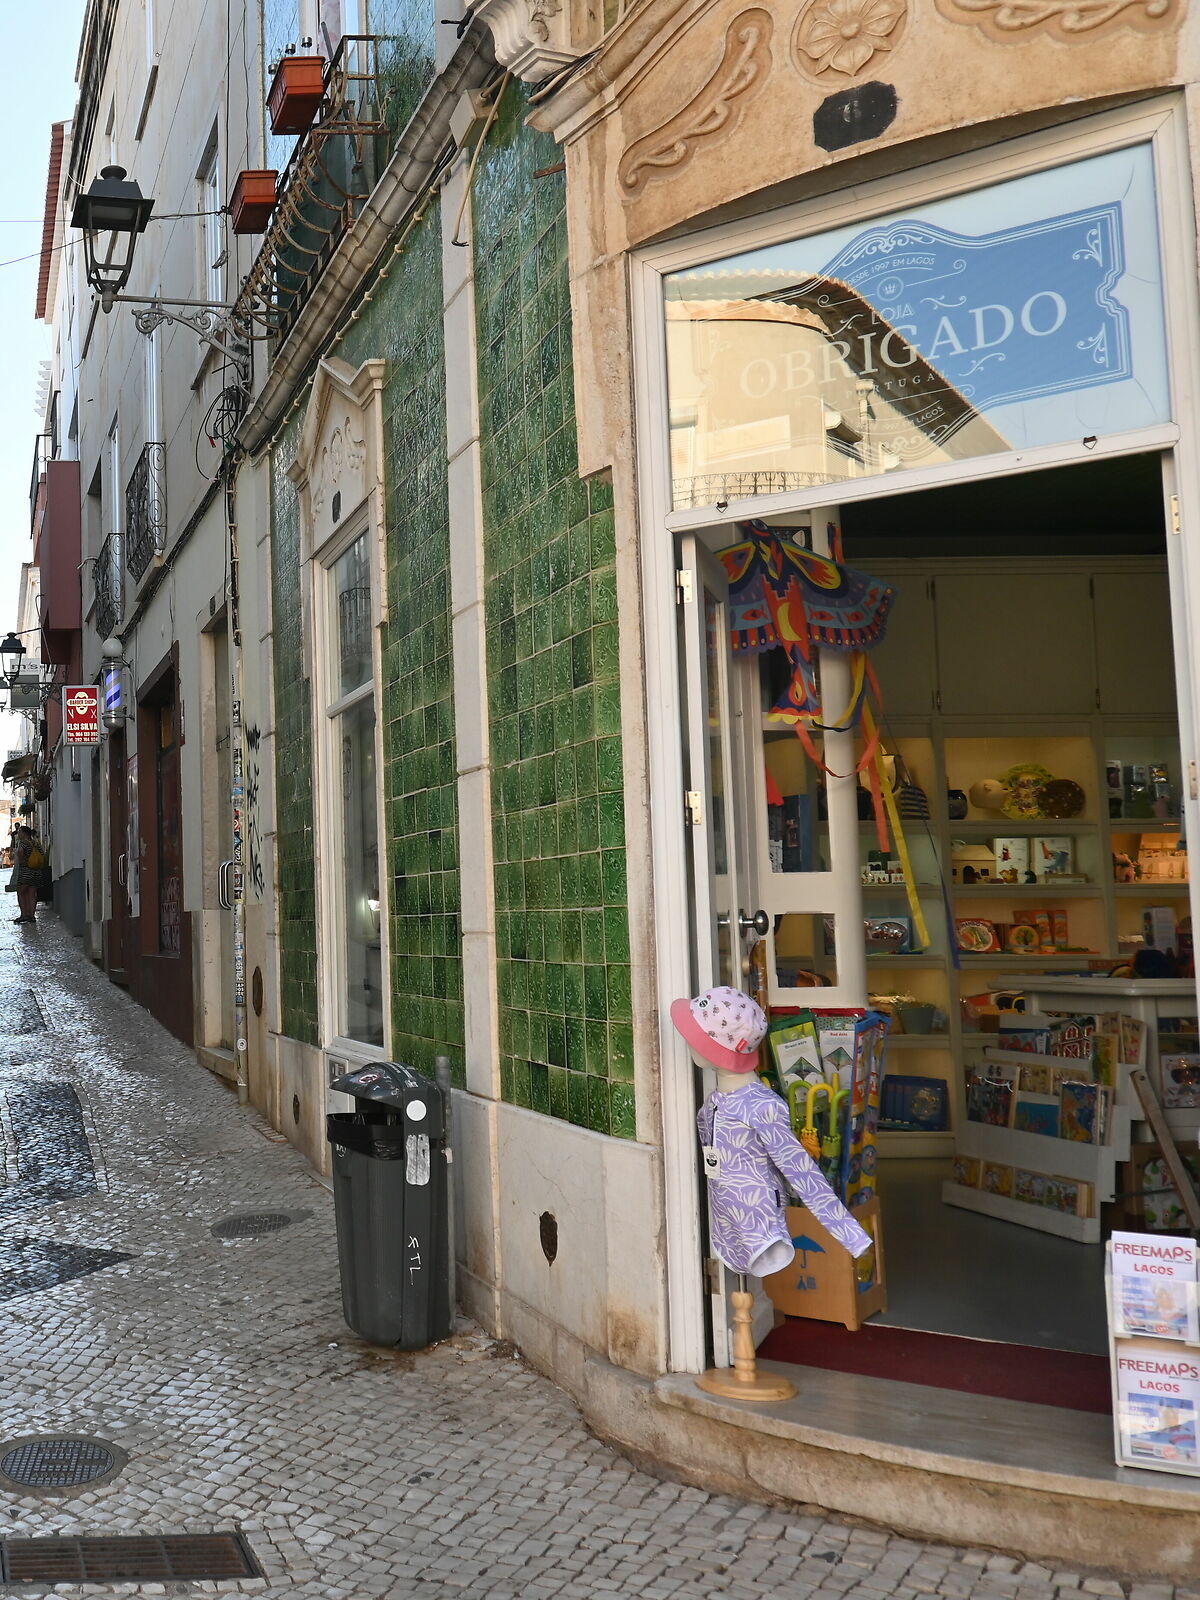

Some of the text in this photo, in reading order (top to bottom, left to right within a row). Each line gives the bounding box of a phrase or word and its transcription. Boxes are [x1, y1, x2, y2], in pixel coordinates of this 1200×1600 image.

[871, 261, 890, 274] 1997
[892, 257, 906, 267] EM
[906, 256, 935, 266] LAGOS
[872, 303, 915, 326] LOJA
[738, 290, 1068, 400] OBRIGADO
[916, 405, 944, 424] LAGOS
[67, 723, 98, 731] ELSI SILVA
[1114, 1242, 1193, 1262] FREEMAPS
[1133, 1263, 1175, 1276] LAGOS
[1118, 1358, 1199, 1379] FREEMAPS
[1139, 1380, 1180, 1393] LAGOS
